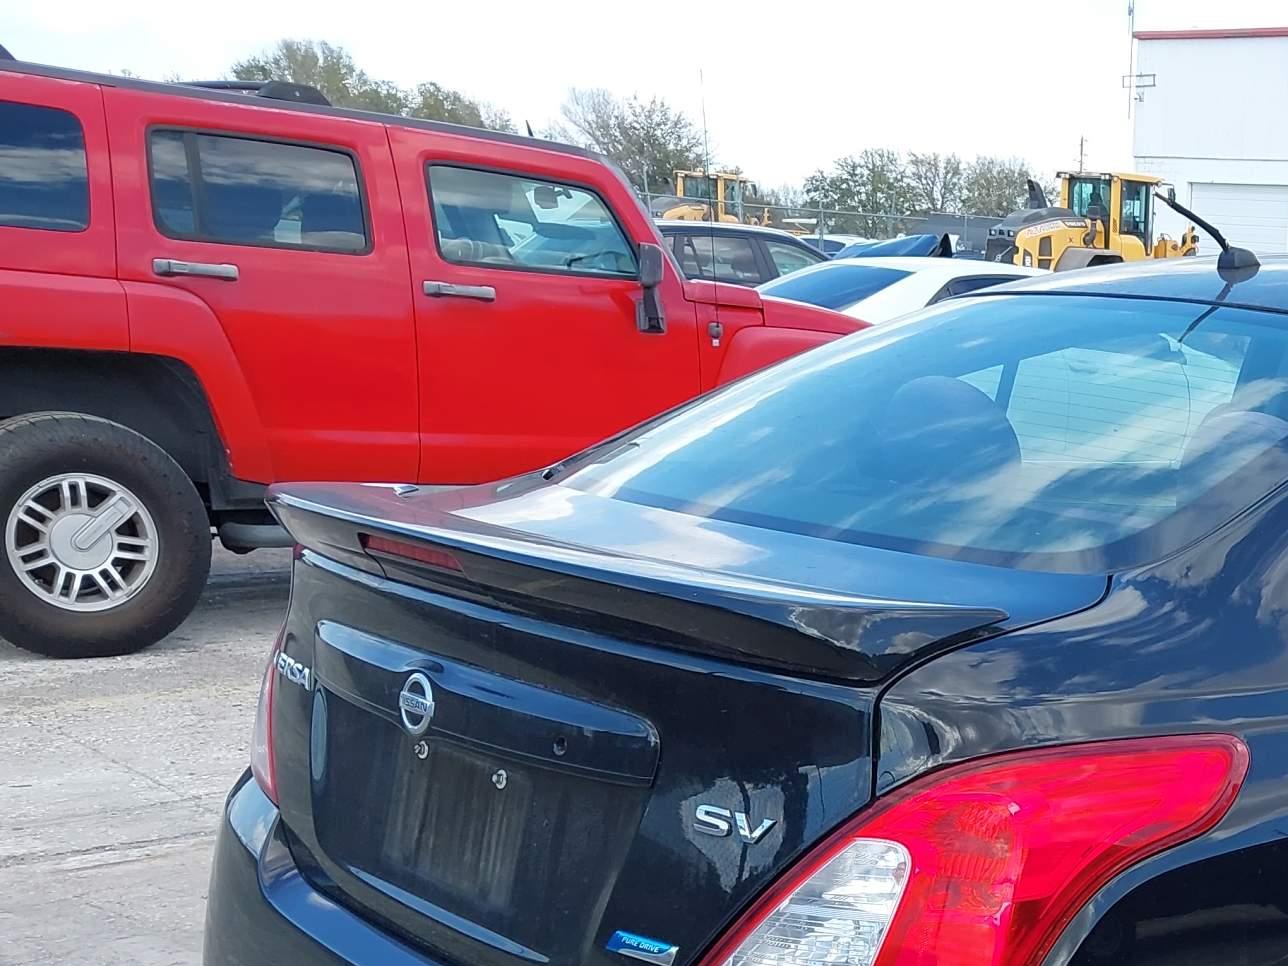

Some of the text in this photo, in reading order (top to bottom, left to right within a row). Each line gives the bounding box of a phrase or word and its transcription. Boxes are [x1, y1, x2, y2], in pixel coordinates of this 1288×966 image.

[693, 804, 777, 844] SV
[621, 936, 660, 953] PURE DRIVE
